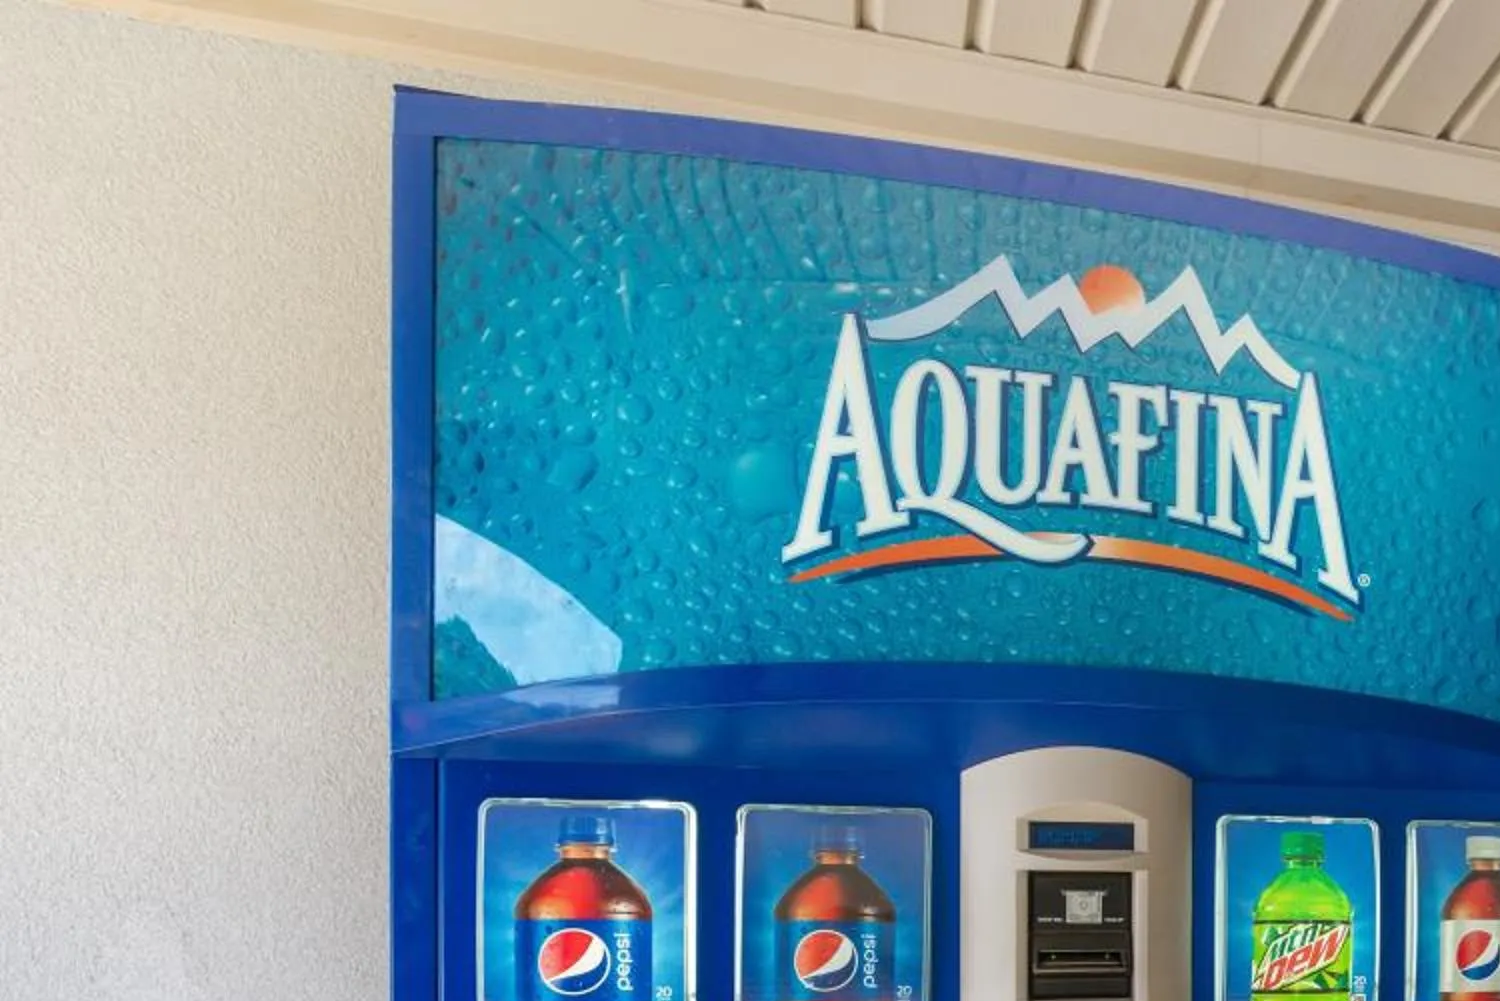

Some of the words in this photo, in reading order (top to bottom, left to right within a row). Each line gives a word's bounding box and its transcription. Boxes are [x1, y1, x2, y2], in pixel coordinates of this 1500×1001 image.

[781, 312, 1360, 604] AQUAFINA
[613, 932, 634, 991] pepsi
[861, 933, 879, 989] pepsi
